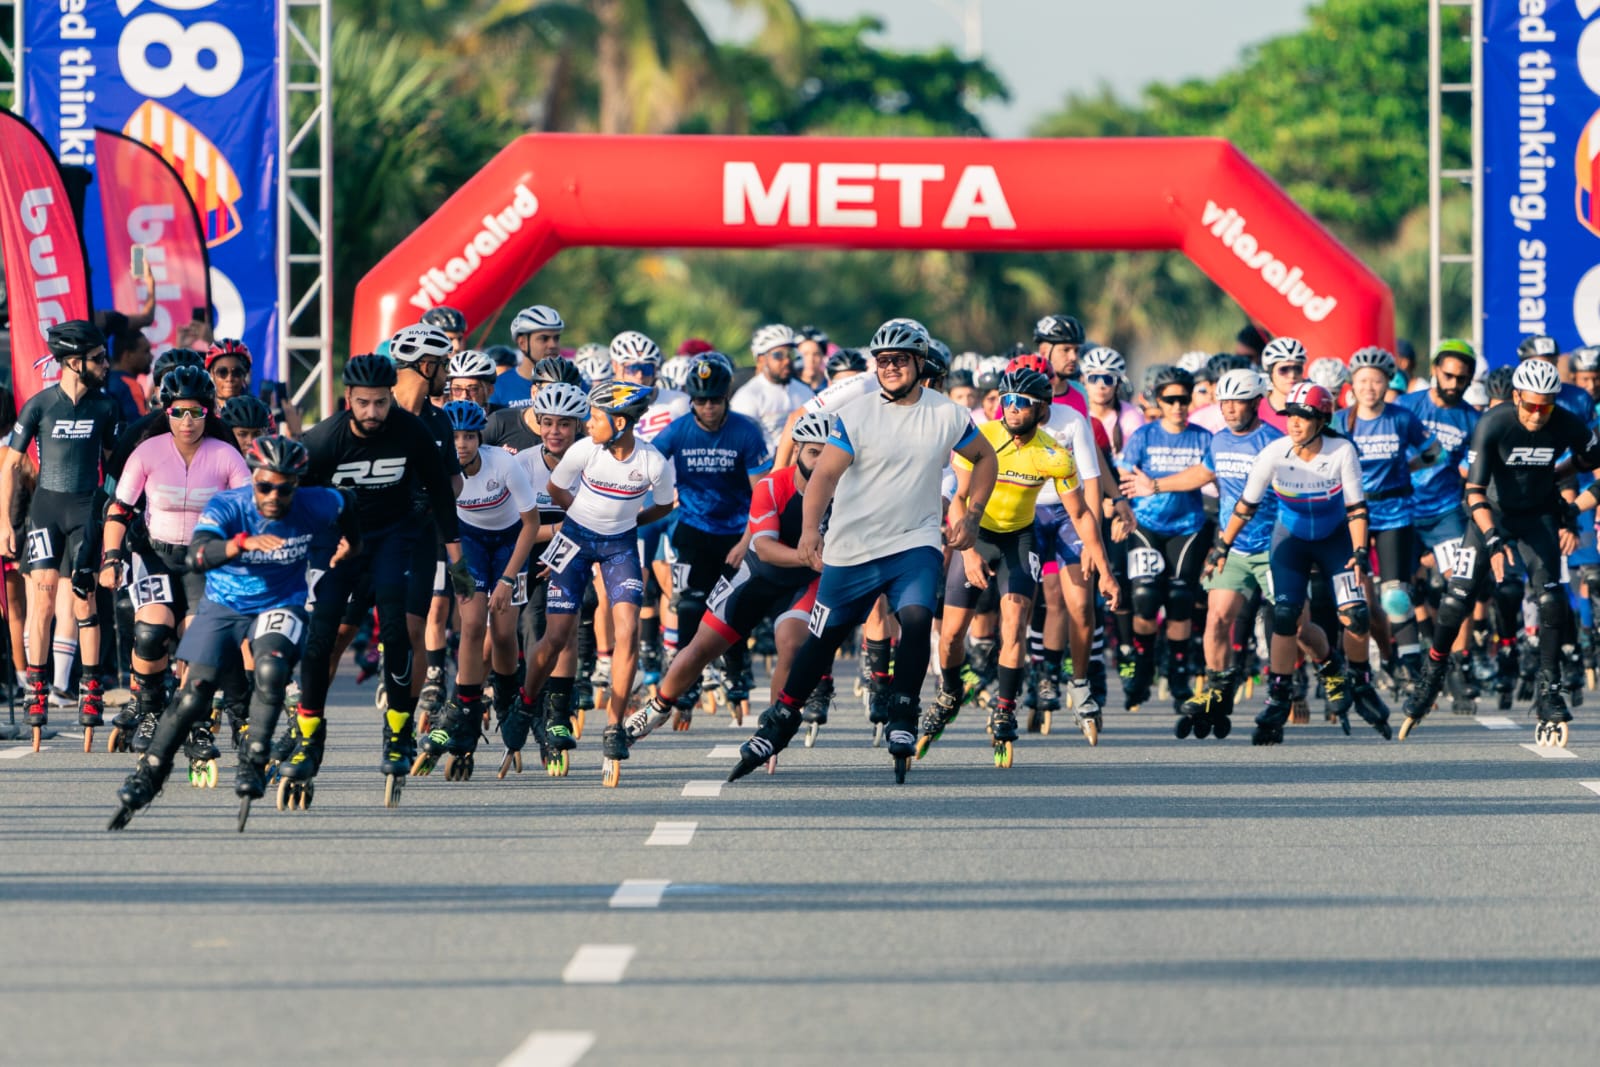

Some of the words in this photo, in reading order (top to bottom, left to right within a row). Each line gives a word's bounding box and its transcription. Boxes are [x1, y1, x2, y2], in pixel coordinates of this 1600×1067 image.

[1510, 49, 1556, 232] thinking,
[723, 161, 1017, 230] META
[409, 184, 539, 311] vitasalud
[1202, 199, 1338, 322] vitasalud
[52, 420, 94, 434] RS
[1506, 447, 1555, 463] RS
[331, 457, 407, 484] RS
[153, 485, 220, 508] RS
[1135, 551, 1159, 574] 132
[135, 576, 167, 605] 152
[264, 612, 298, 641] 127
